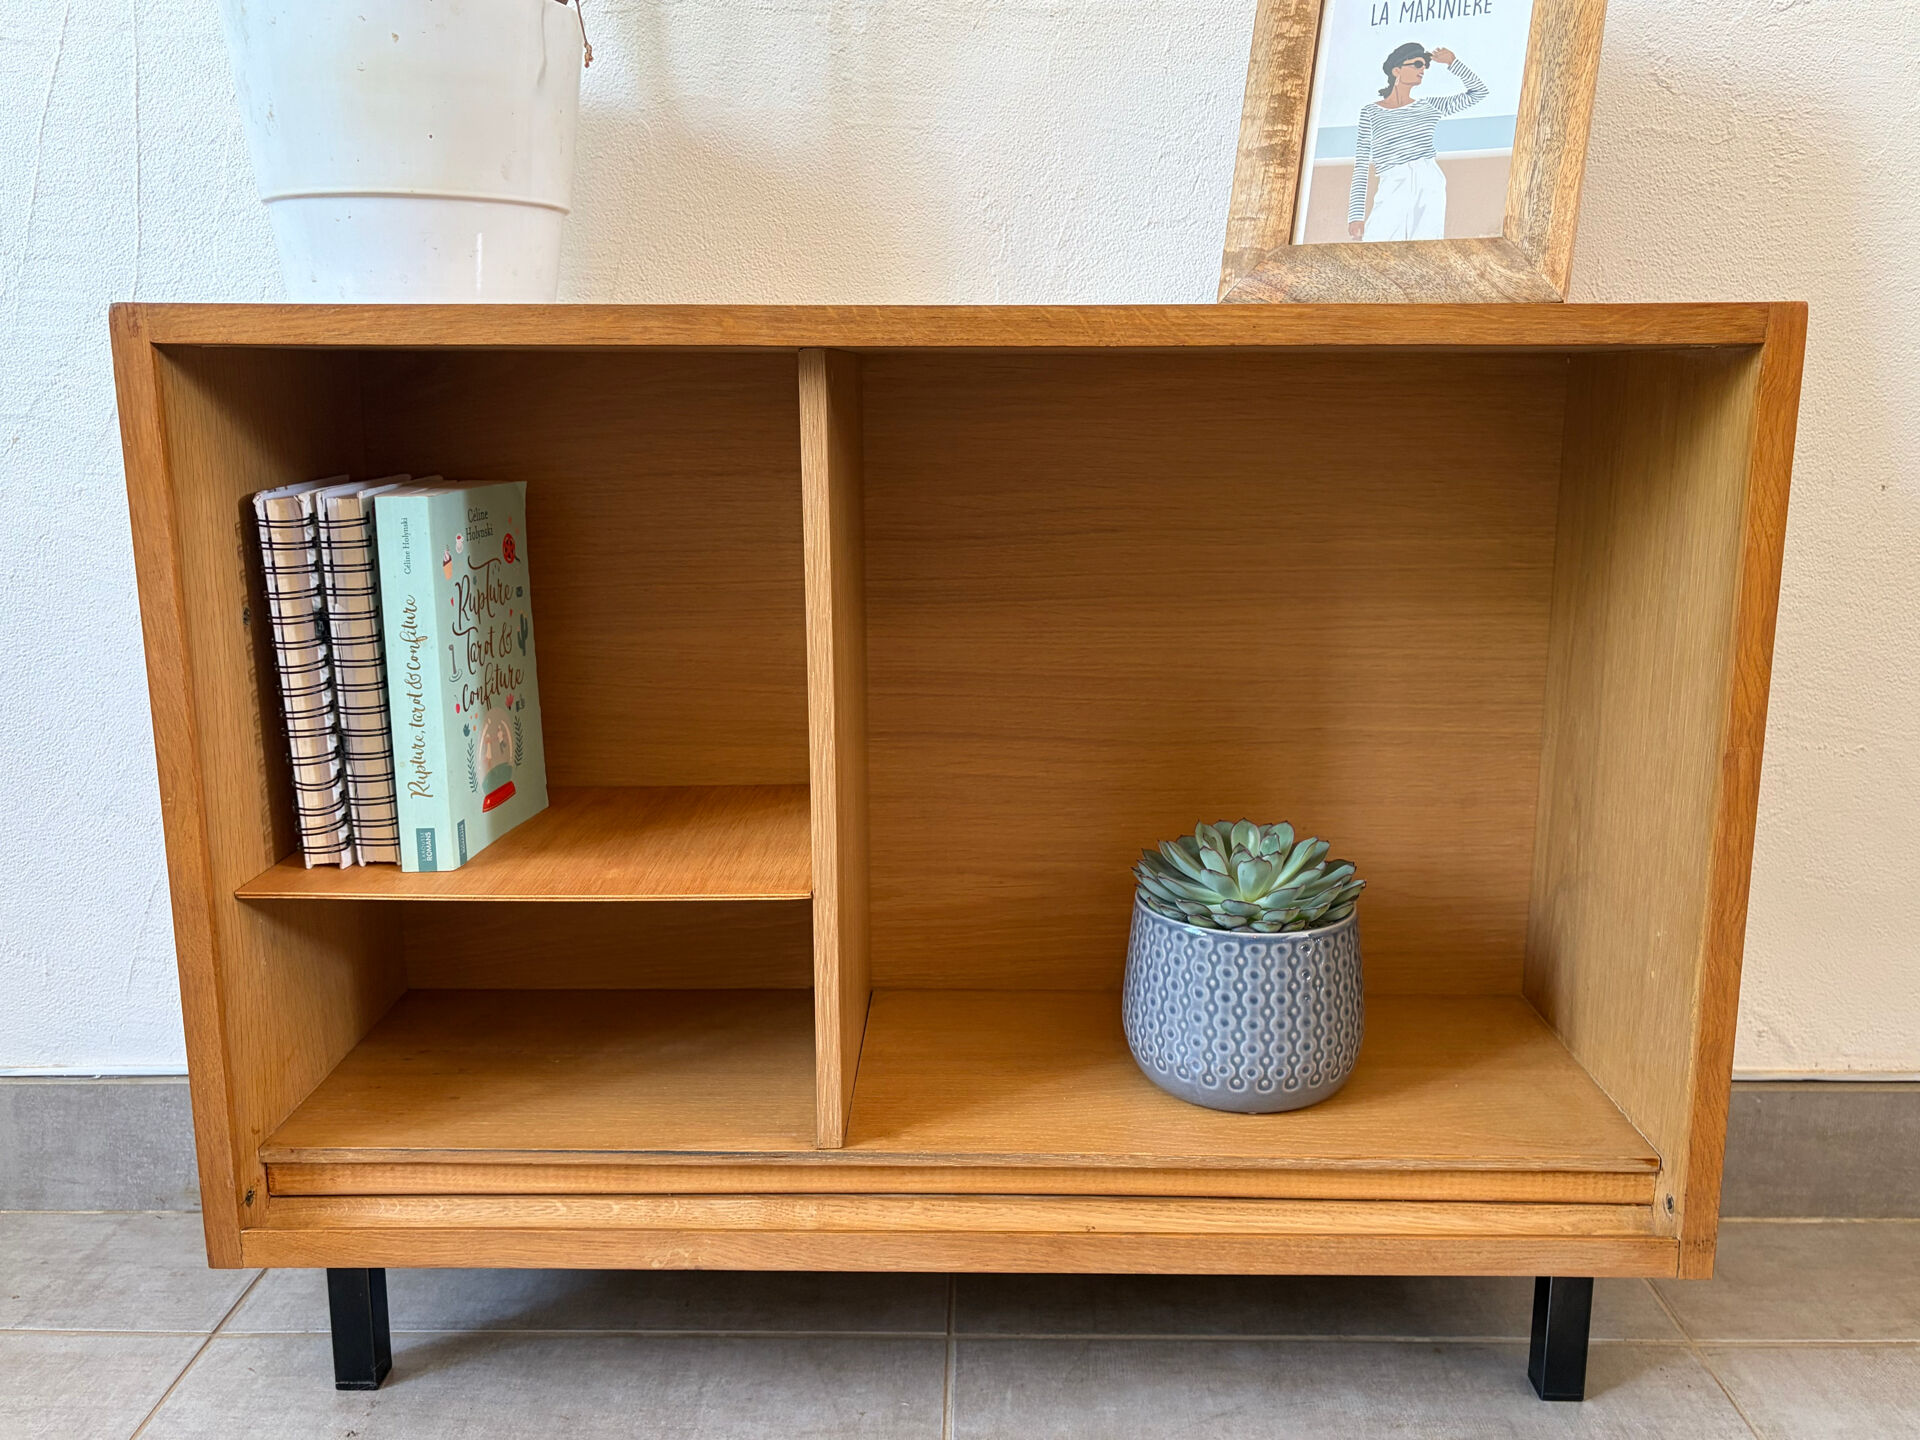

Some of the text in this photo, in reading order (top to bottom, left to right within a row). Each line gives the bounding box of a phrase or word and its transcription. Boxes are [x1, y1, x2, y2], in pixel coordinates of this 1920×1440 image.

[1371, 1, 1389, 26] LA
[465, 523, 494, 543] Holynski
[467, 507, 488, 522] Céline
[401, 517, 412, 575] Céline Holynski
[455, 555, 514, 630] Rupture
[399, 594, 428, 670] Confiture
[452, 622, 513, 675] Tarot &
[403, 671, 423, 690] &
[462, 662, 525, 712] Confiture
[405, 691, 426, 729] tarot
[424, 831, 433, 862] ROMANS
